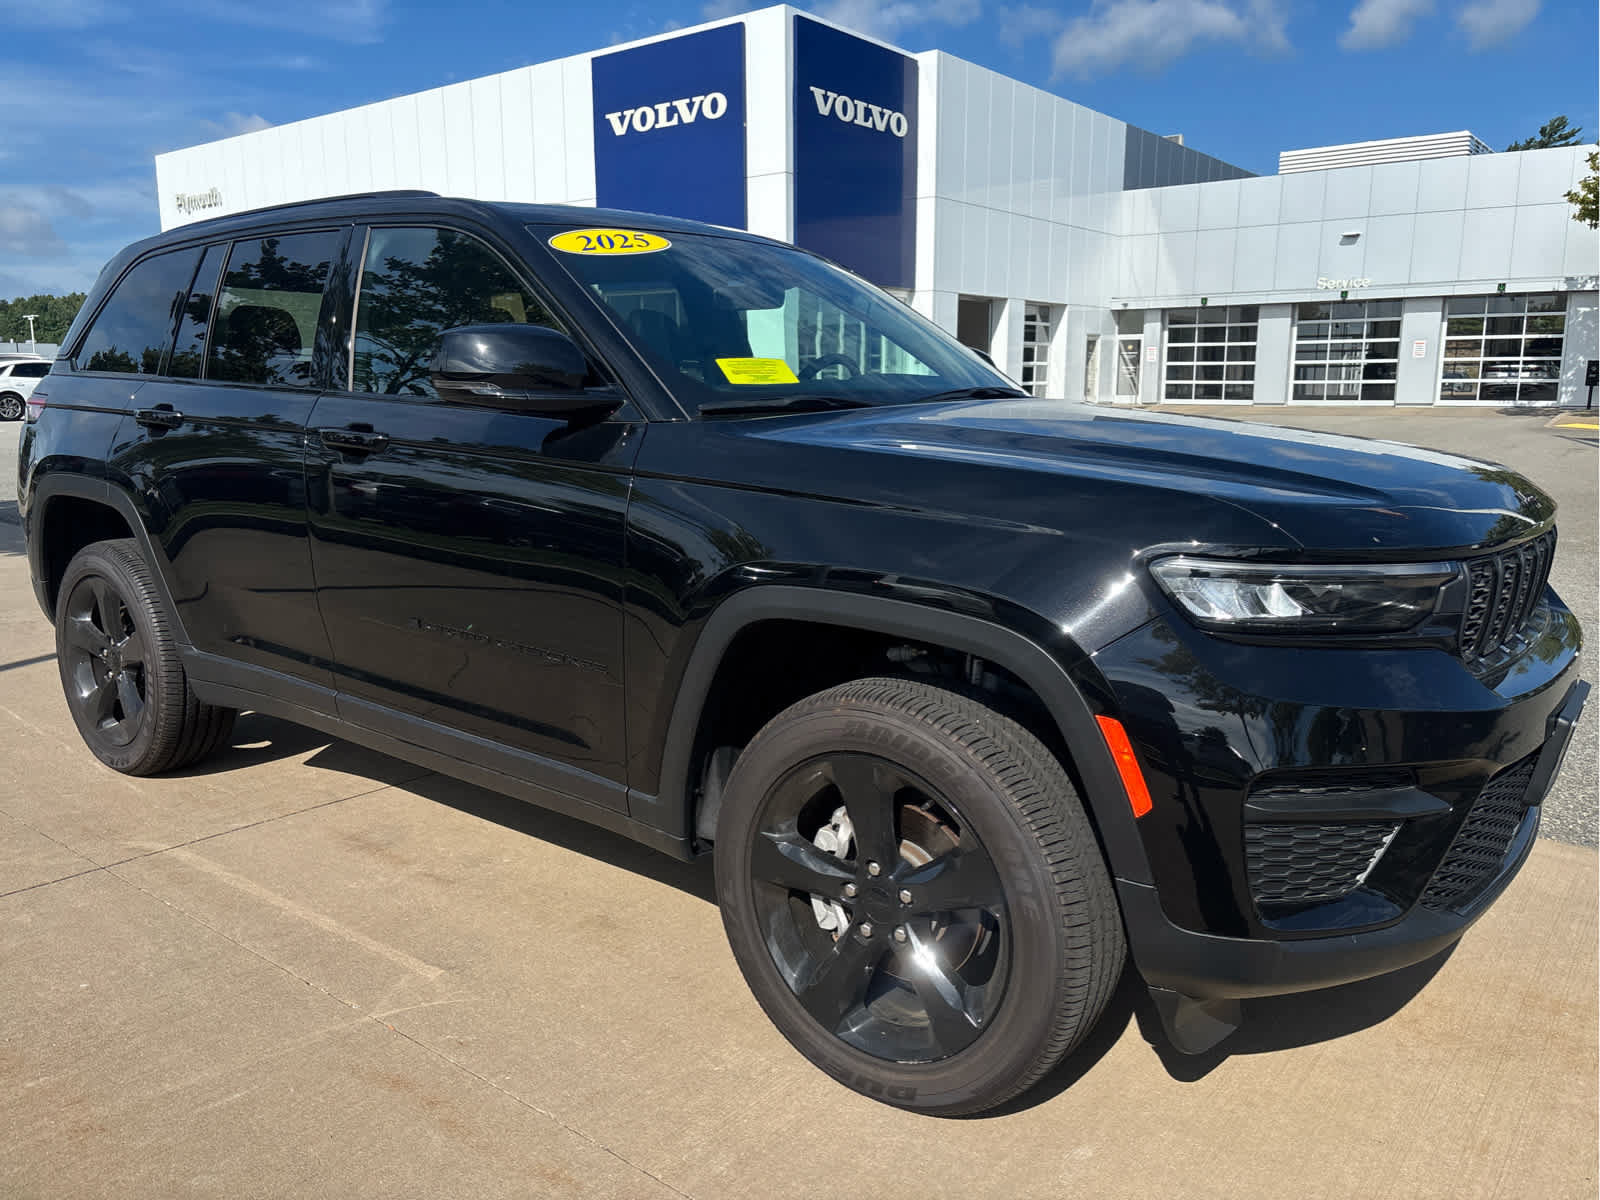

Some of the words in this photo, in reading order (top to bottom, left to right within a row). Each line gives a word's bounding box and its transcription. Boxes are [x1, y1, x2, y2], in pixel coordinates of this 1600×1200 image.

[605, 92, 728, 136] VOLVO
[810, 86, 908, 137] VOLVO
[176, 187, 223, 215] Plymouth
[576, 233, 650, 251] 2025
[1317, 276, 1371, 290] Service
